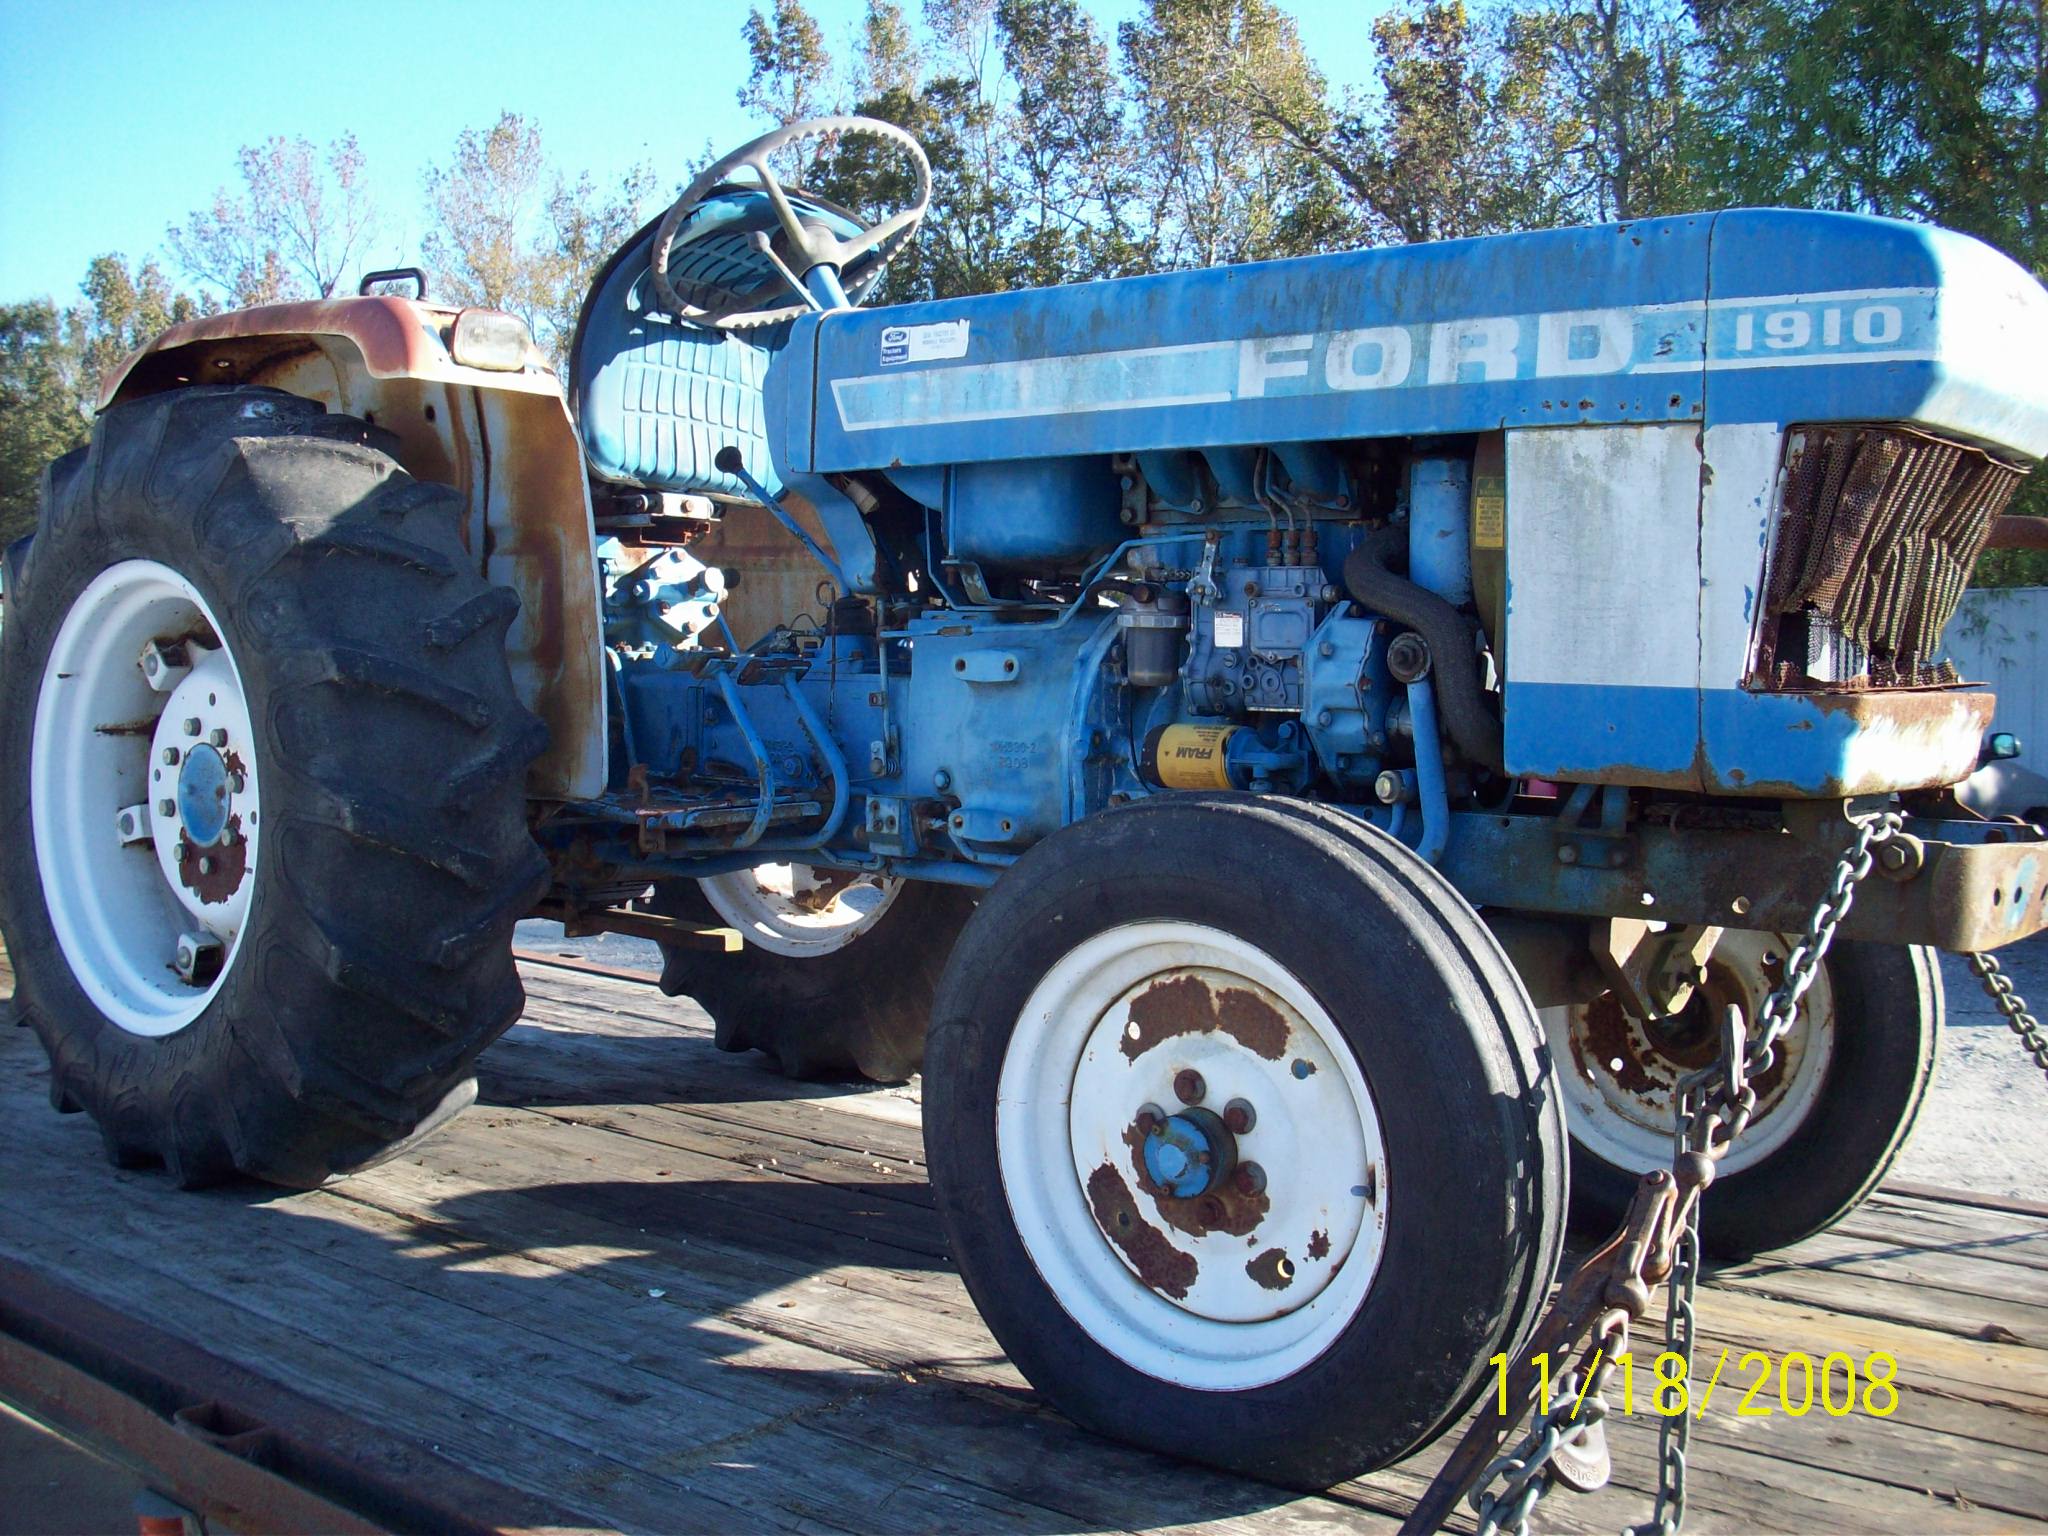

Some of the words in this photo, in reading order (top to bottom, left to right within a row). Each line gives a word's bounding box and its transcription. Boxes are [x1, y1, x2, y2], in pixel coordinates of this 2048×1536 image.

[1237, 309, 1633, 398] FORD
[1736, 305, 1901, 350] 1910
[1175, 746, 1213, 760] FRAM
